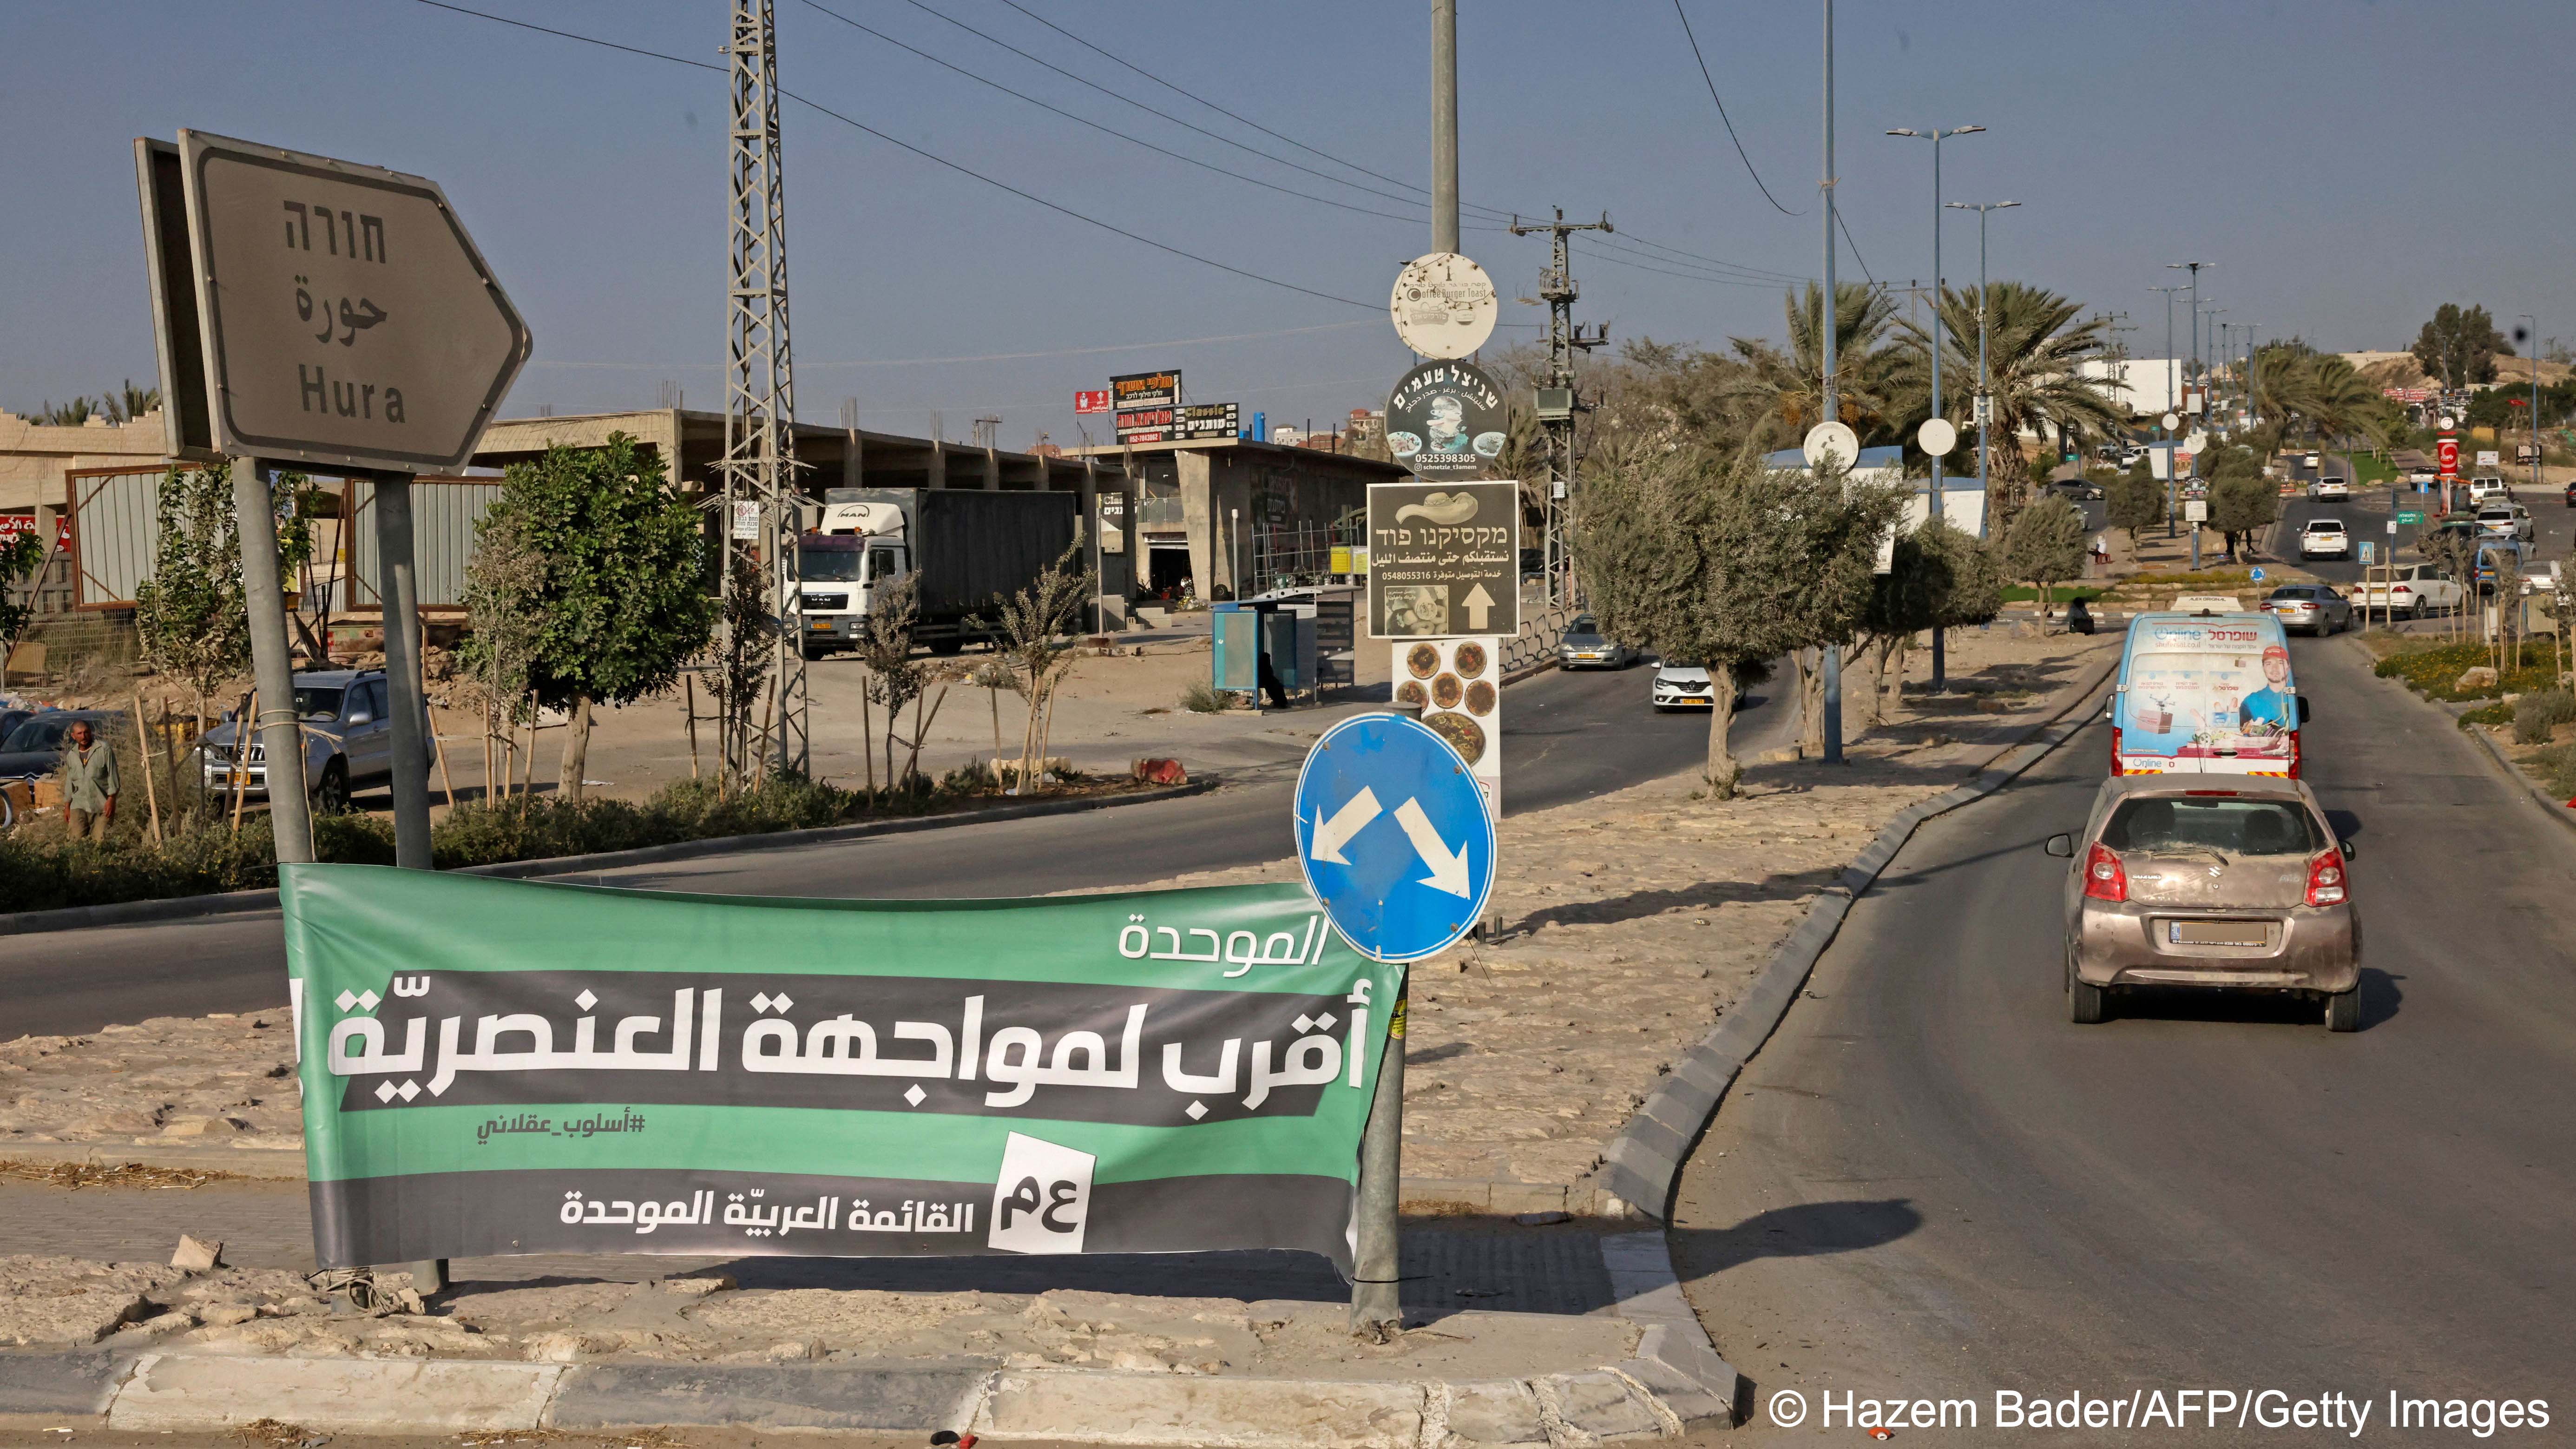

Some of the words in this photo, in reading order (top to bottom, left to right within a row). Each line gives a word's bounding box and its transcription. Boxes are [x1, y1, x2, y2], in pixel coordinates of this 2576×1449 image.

[283, 200, 386, 264] חורה
[1442, 290, 1465, 299] Burger
[1468, 289, 1486, 297] Toast
[296, 274, 388, 347] حورة
[298, 364, 406, 424] Hura
[1394, 368, 1444, 410] טעמים
[1451, 364, 1498, 409] שניצל
[1185, 404, 1225, 417] Classic
[1188, 418, 1226, 431] מותגים
[1415, 454, 1476, 463] 0525398305
[1376, 528, 1411, 546] פוד
[1419, 527, 1507, 549] מקסיקנו
[1371, 552, 1396, 567] الليل
[1398, 552, 1436, 564] منتصف
[1438, 551, 1459, 566] حتى
[1463, 550, 1509, 566] نستقبلكم
[1382, 571, 1431, 580] 0548055316
[1433, 570, 1455, 580] متوفرة
[1456, 570, 1483, 580] التوصيل
[1484, 569, 1502, 578] خدمة
[2155, 627, 2201, 642] Online
[2208, 629, 2257, 641] שופרסל
[2133, 758, 2162, 768] Online
[1119, 913, 1331, 979] الموحدة
[327, 976, 723, 1104] العنصريّة
[742, 991, 1149, 1108] لمواجهة
[1162, 978, 1373, 1121] أقرب
[560, 1189, 715, 1234] الموحدة
[723, 1188, 837, 1237] العربيّة
[848, 1198, 974, 1233] القائمة
